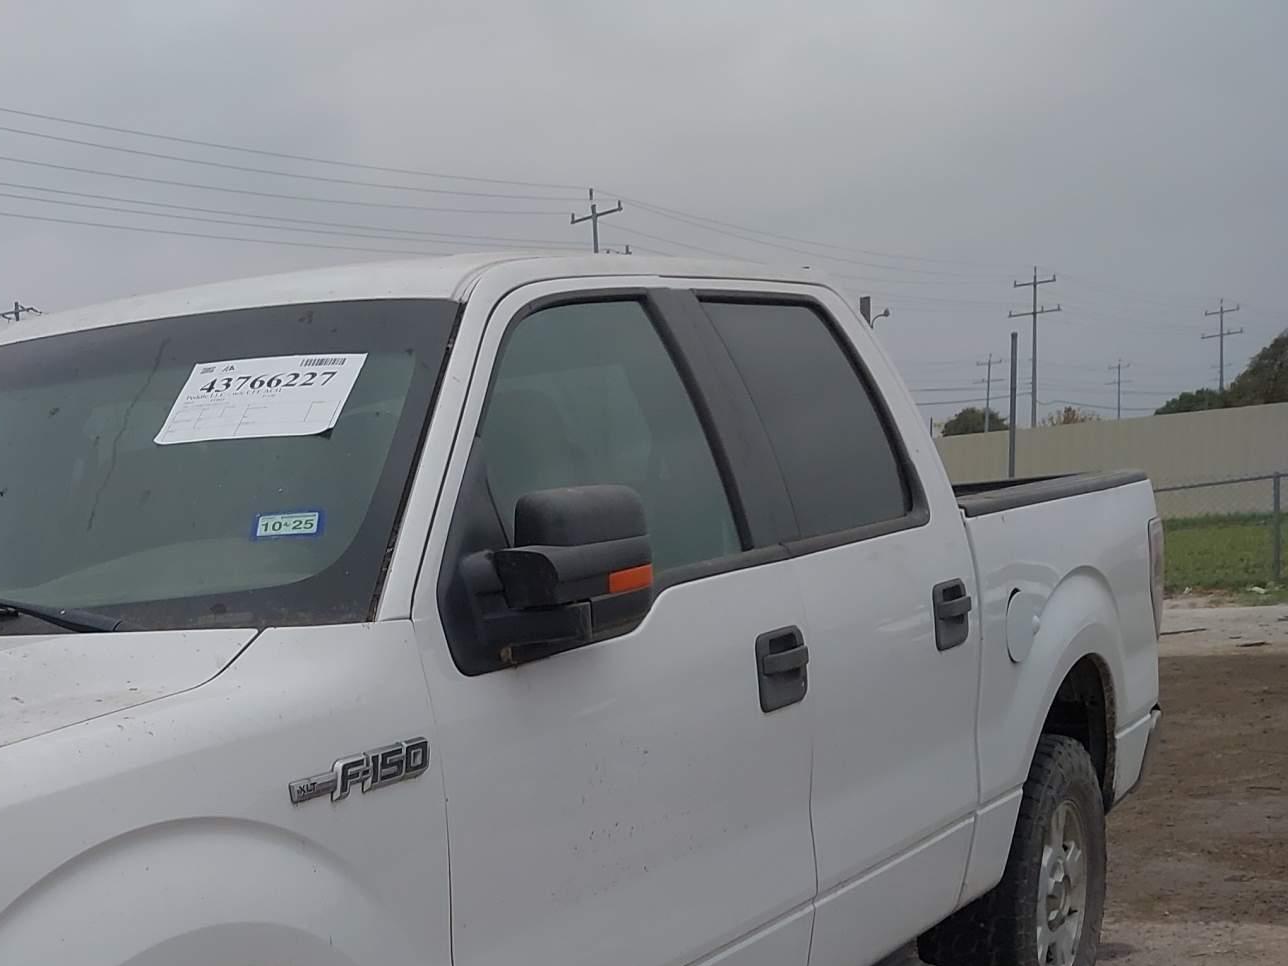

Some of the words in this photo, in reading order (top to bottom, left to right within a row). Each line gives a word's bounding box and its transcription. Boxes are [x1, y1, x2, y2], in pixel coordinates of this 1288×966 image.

[200, 371, 338, 394] 43766227
[262, 521, 282, 532] 10
[291, 519, 314, 530] 25
